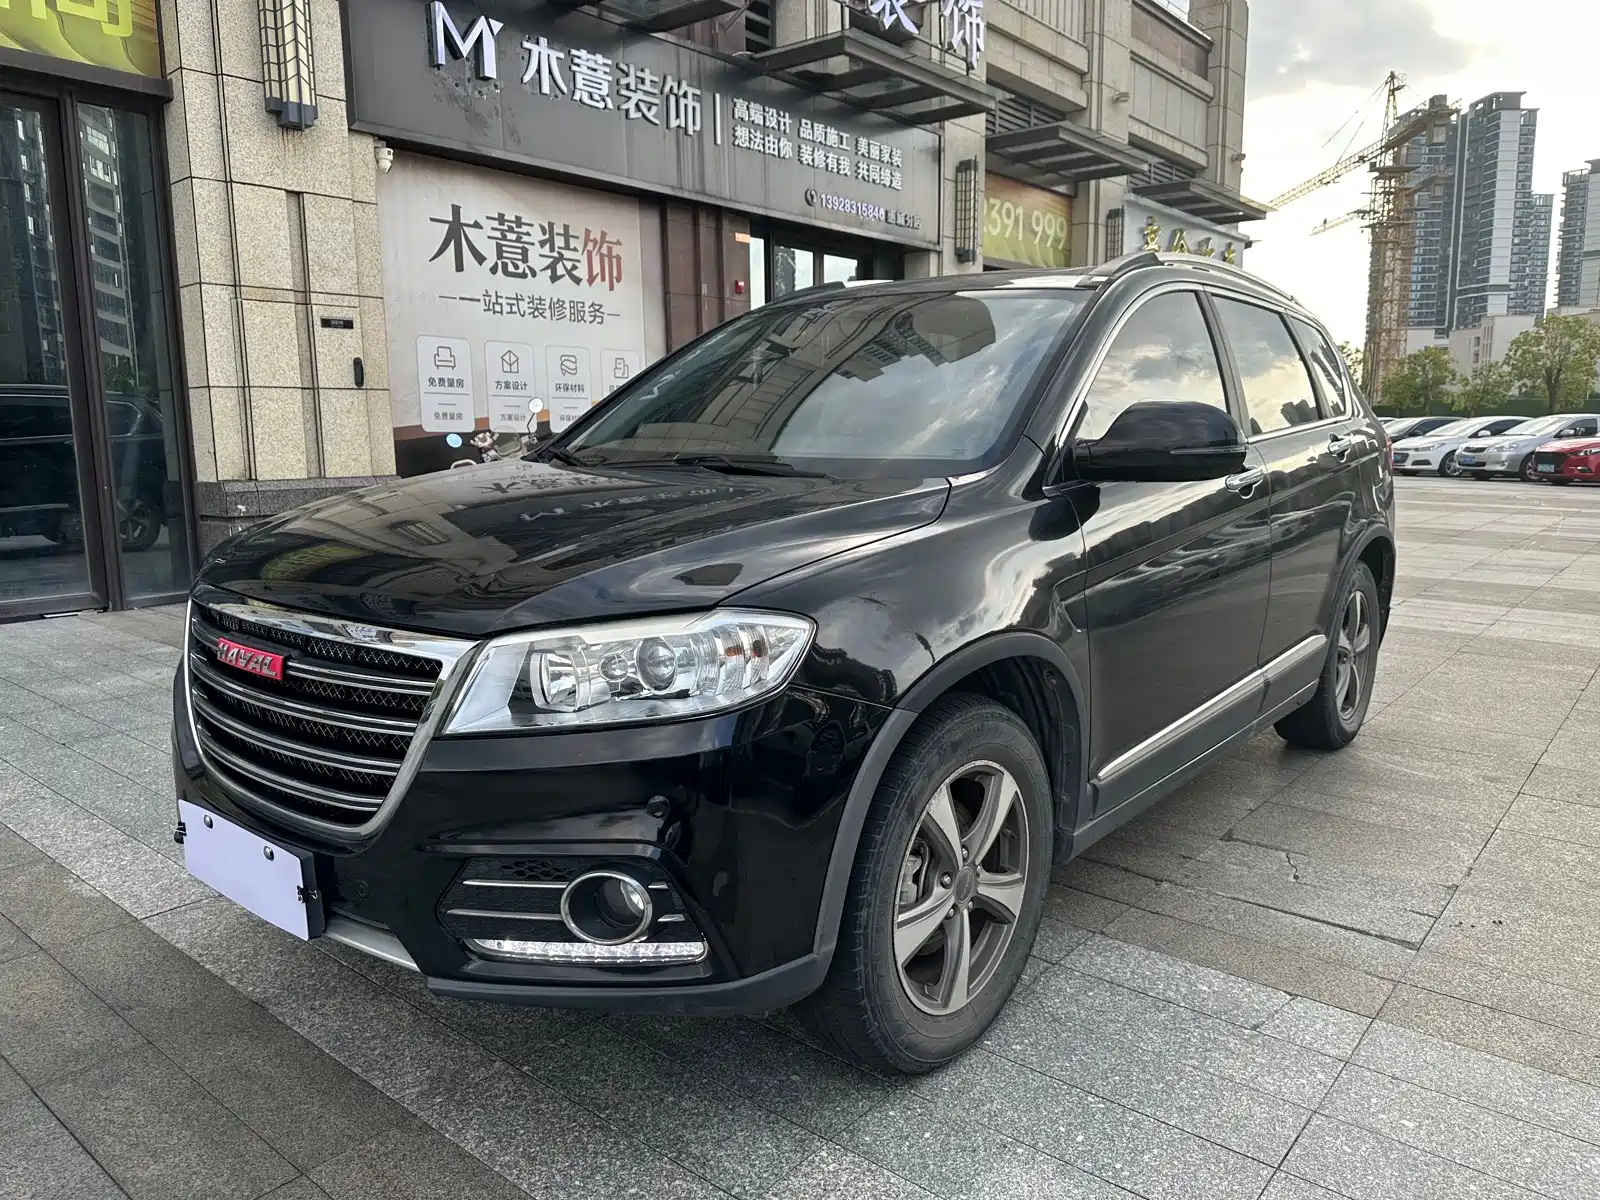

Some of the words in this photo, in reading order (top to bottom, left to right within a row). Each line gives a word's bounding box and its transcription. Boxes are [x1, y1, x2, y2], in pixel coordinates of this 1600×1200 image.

[519, 36, 702, 137] 木薏装饰
[733, 98, 793, 134] 高端设计
[799, 118, 851, 151] 品质施工
[856, 136, 903, 168] 美丽家装
[733, 125, 793, 160] 想法由你
[799, 144, 851, 176] 装修有我
[856, 160, 903, 191] 共同缔造
[428, 203, 623, 292] 木薏装饰
[1031, 209, 1067, 250] 999
[427, 376, 465, 389] 免费量房
[494, 380, 529, 392] 方案设计
[554, 382, 585, 394] 环保材料
[433, 411, 463, 421] 免费量房
[499, 413, 528, 423] 方案设计
[216, 641, 277, 677] HAVAL
